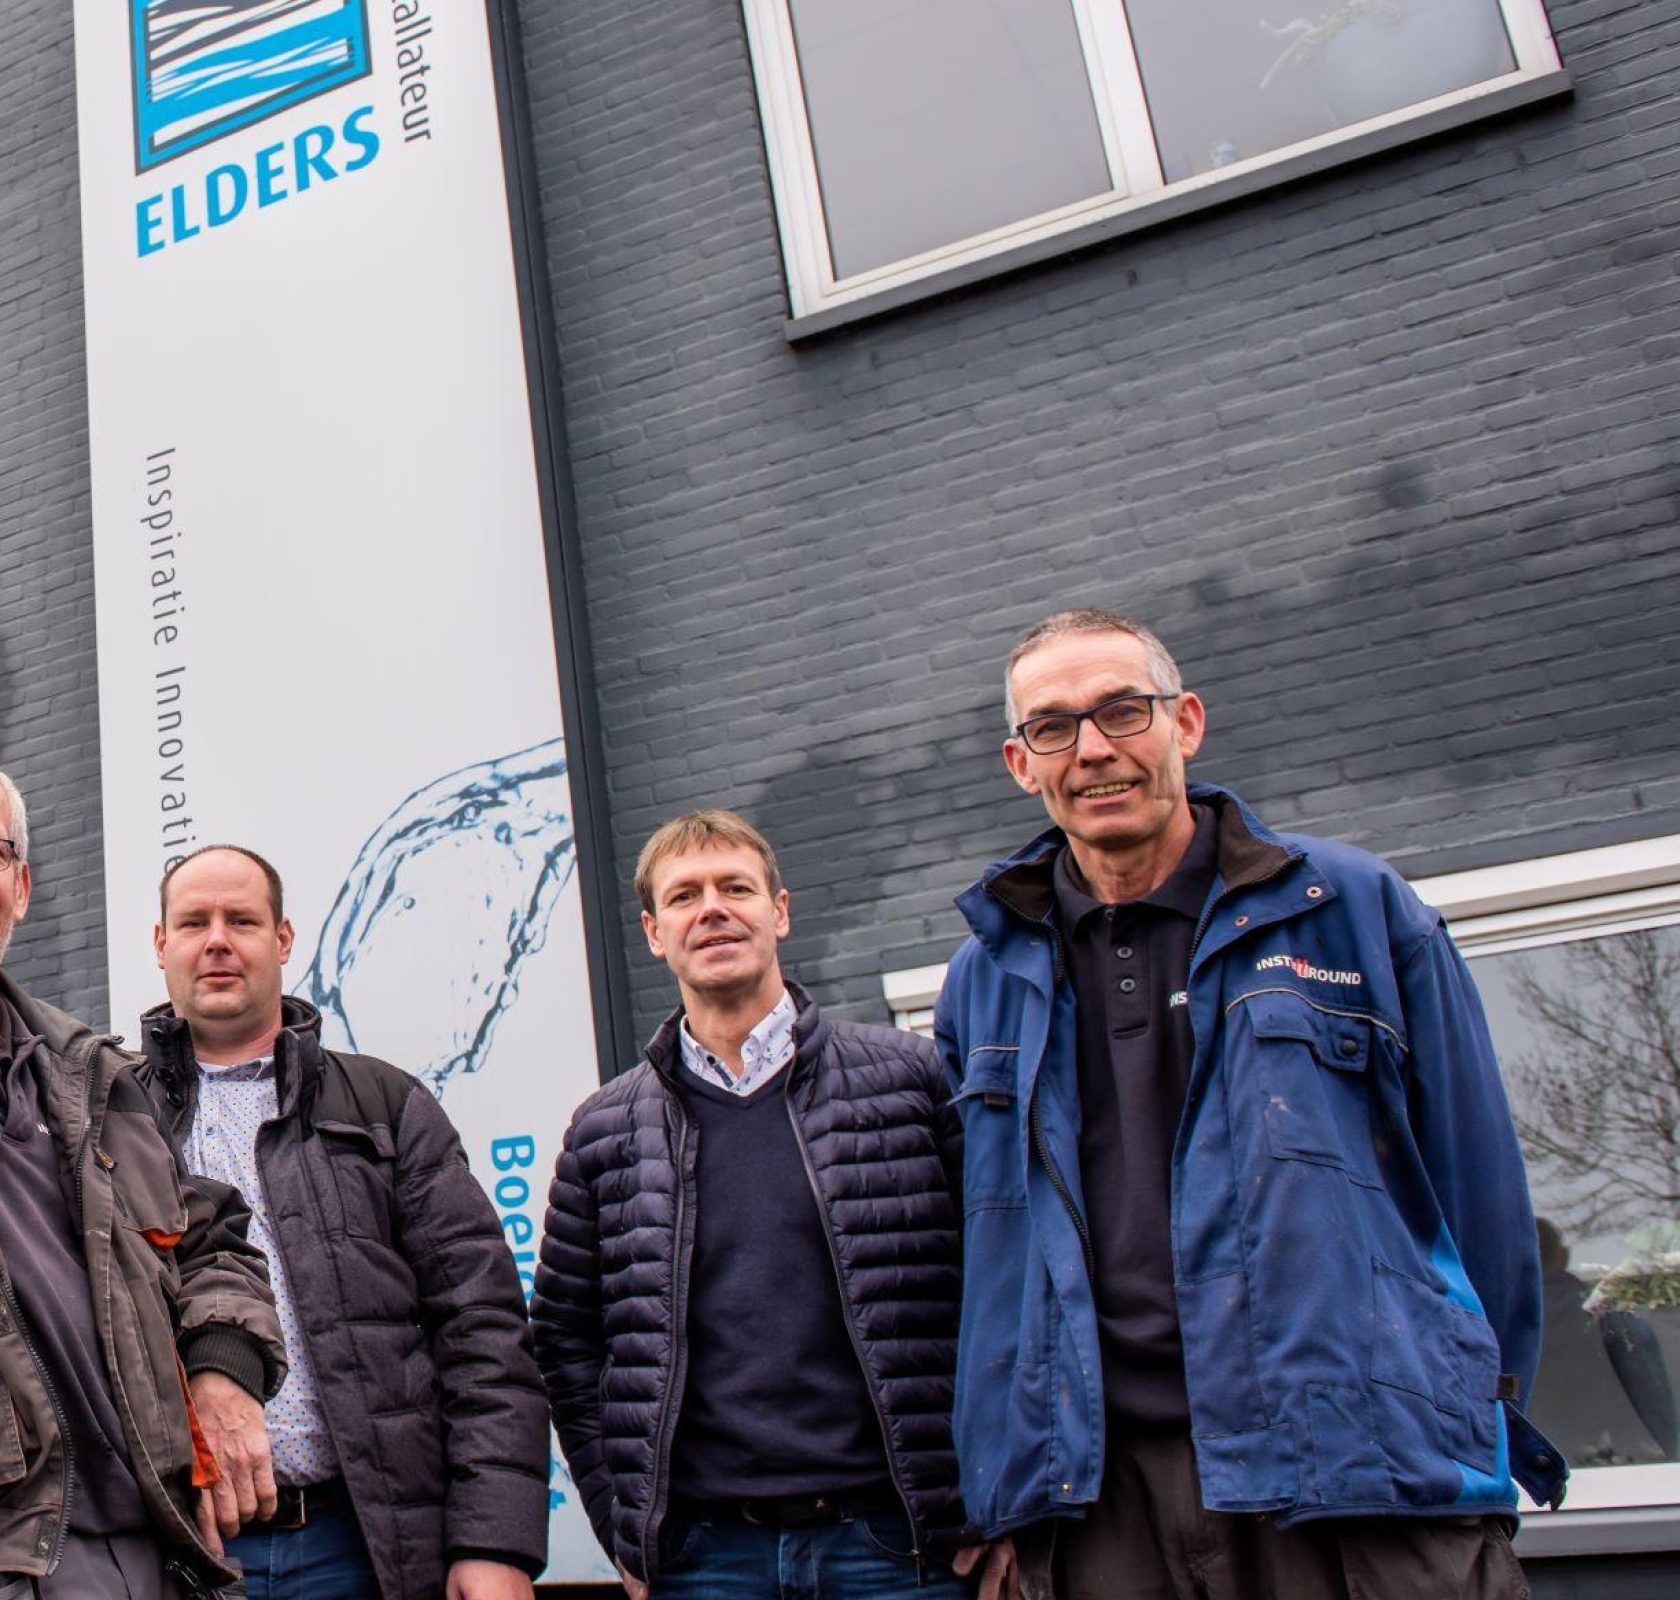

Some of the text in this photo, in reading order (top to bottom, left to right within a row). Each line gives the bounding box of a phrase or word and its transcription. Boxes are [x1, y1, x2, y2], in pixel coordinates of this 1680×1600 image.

[391, 0, 433, 144] allateur
[135, 104, 381, 259] ELDERS
[140, 446, 187, 646] Inspiratie
